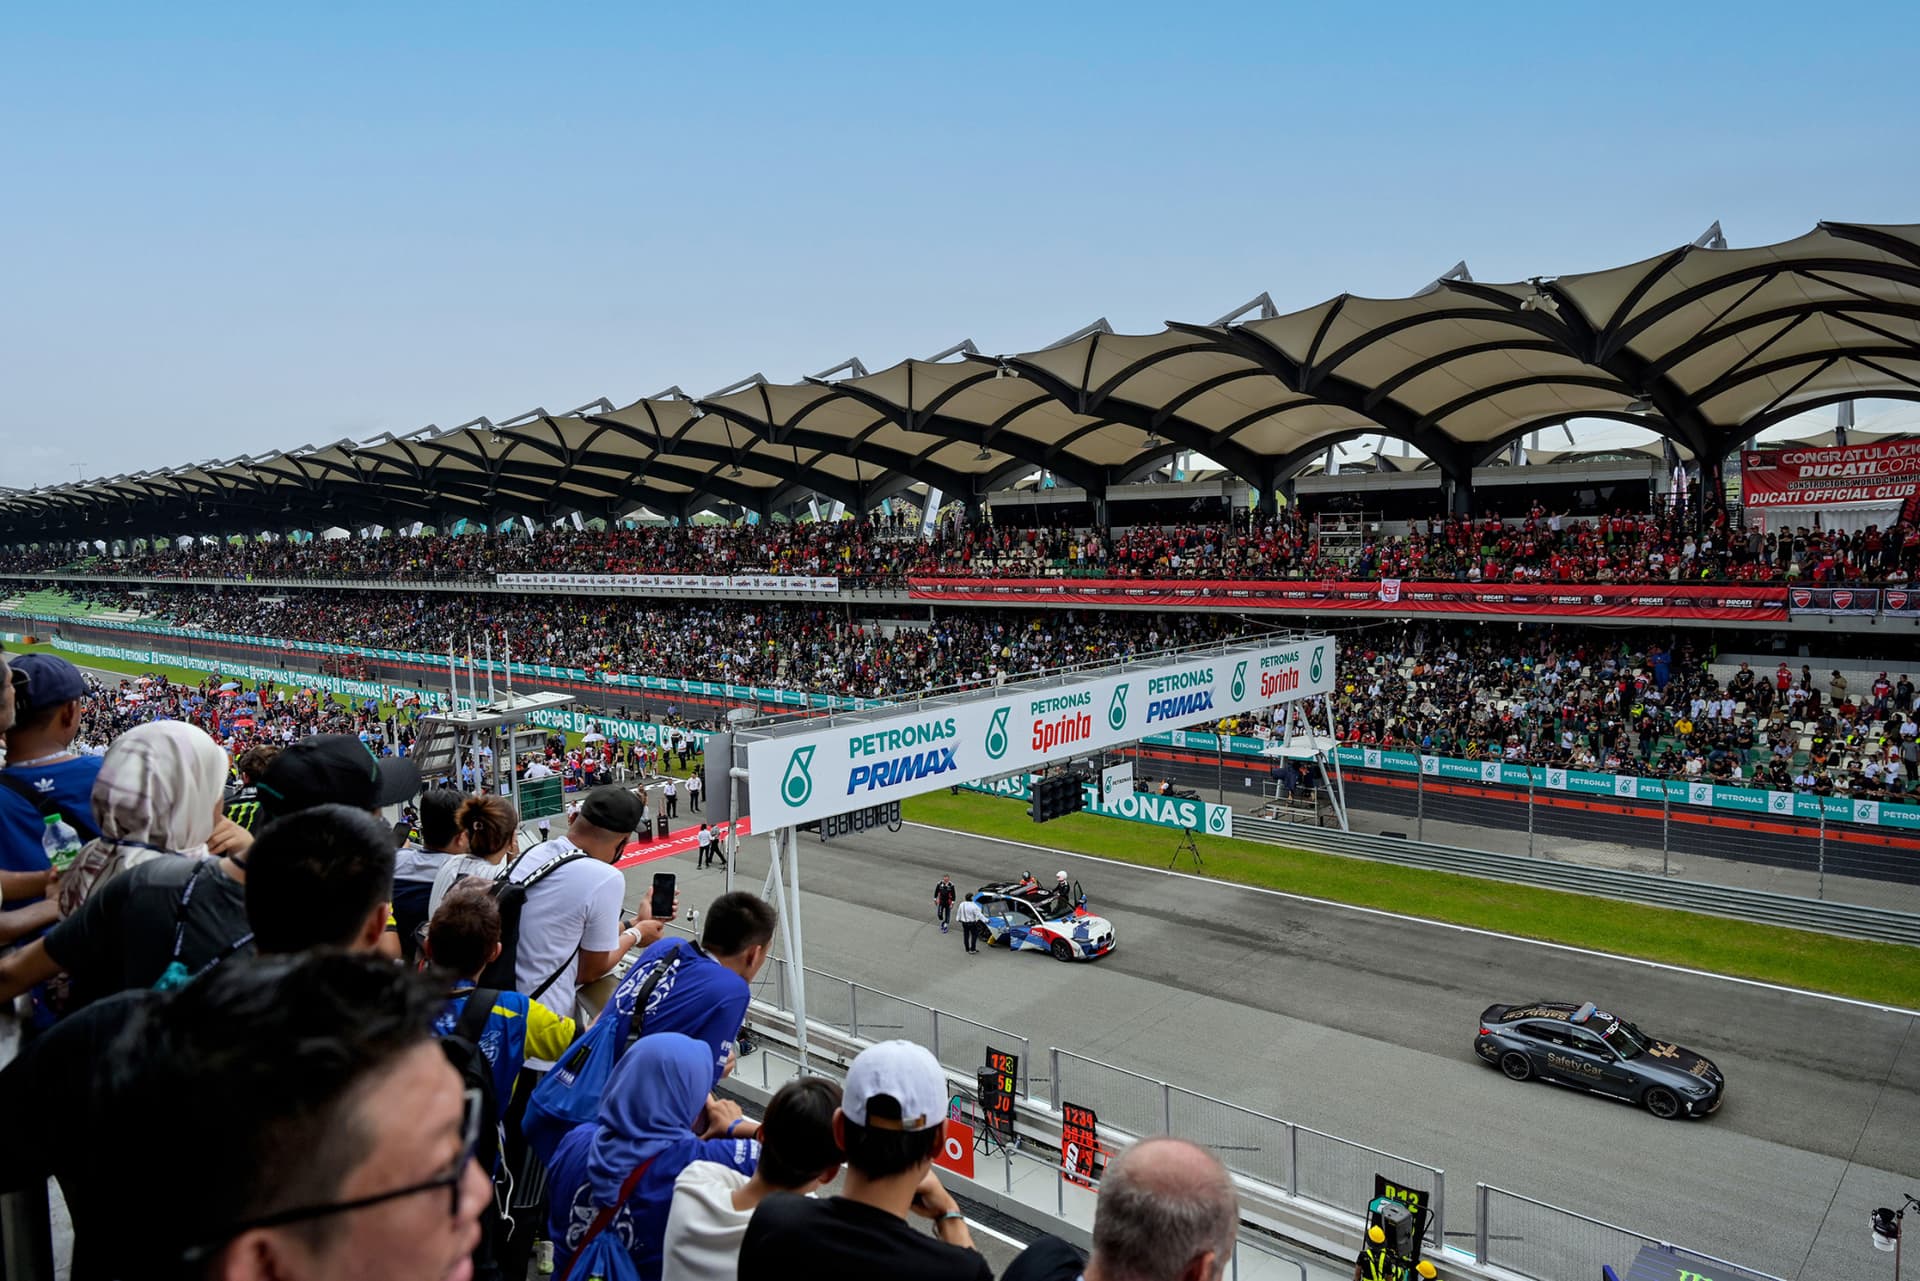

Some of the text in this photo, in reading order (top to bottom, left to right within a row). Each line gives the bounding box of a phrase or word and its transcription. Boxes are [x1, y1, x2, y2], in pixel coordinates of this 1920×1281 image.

[1799, 461, 1877, 478] DUCATI
[1852, 477, 1883, 487] WORLD
[1749, 484, 1916, 504] DUCATI OFFICIAL CLUB
[1260, 651, 1300, 668] PETRONAS
[1149, 668, 1213, 695] PETRONAS
[1260, 667, 1299, 699] Sprinta
[1031, 691, 1091, 716] PETRONAS
[1147, 689, 1214, 724] PRIMAX
[849, 718, 956, 759] PETRONAS
[1032, 711, 1091, 753] Sprinta
[1187, 737, 1214, 745] PETRONAS
[1232, 742, 1261, 750] PETRONAS
[1331, 752, 1363, 761] PTRONAS
[1384, 758, 1418, 767] PETRONAS
[847, 742, 961, 795] PRIMAX
[1442, 764, 1478, 773] PETRONAS
[1504, 770, 1542, 780] PETROAS
[1570, 777, 1611, 788] PETRONAS
[1716, 793, 1764, 804] PETRONAS
[991, 1053, 1014, 1074] 123
[1547, 1052, 1581, 1070] Safety
[1583, 1062, 1604, 1075] Car
[1064, 1105, 1093, 1129] 1234
